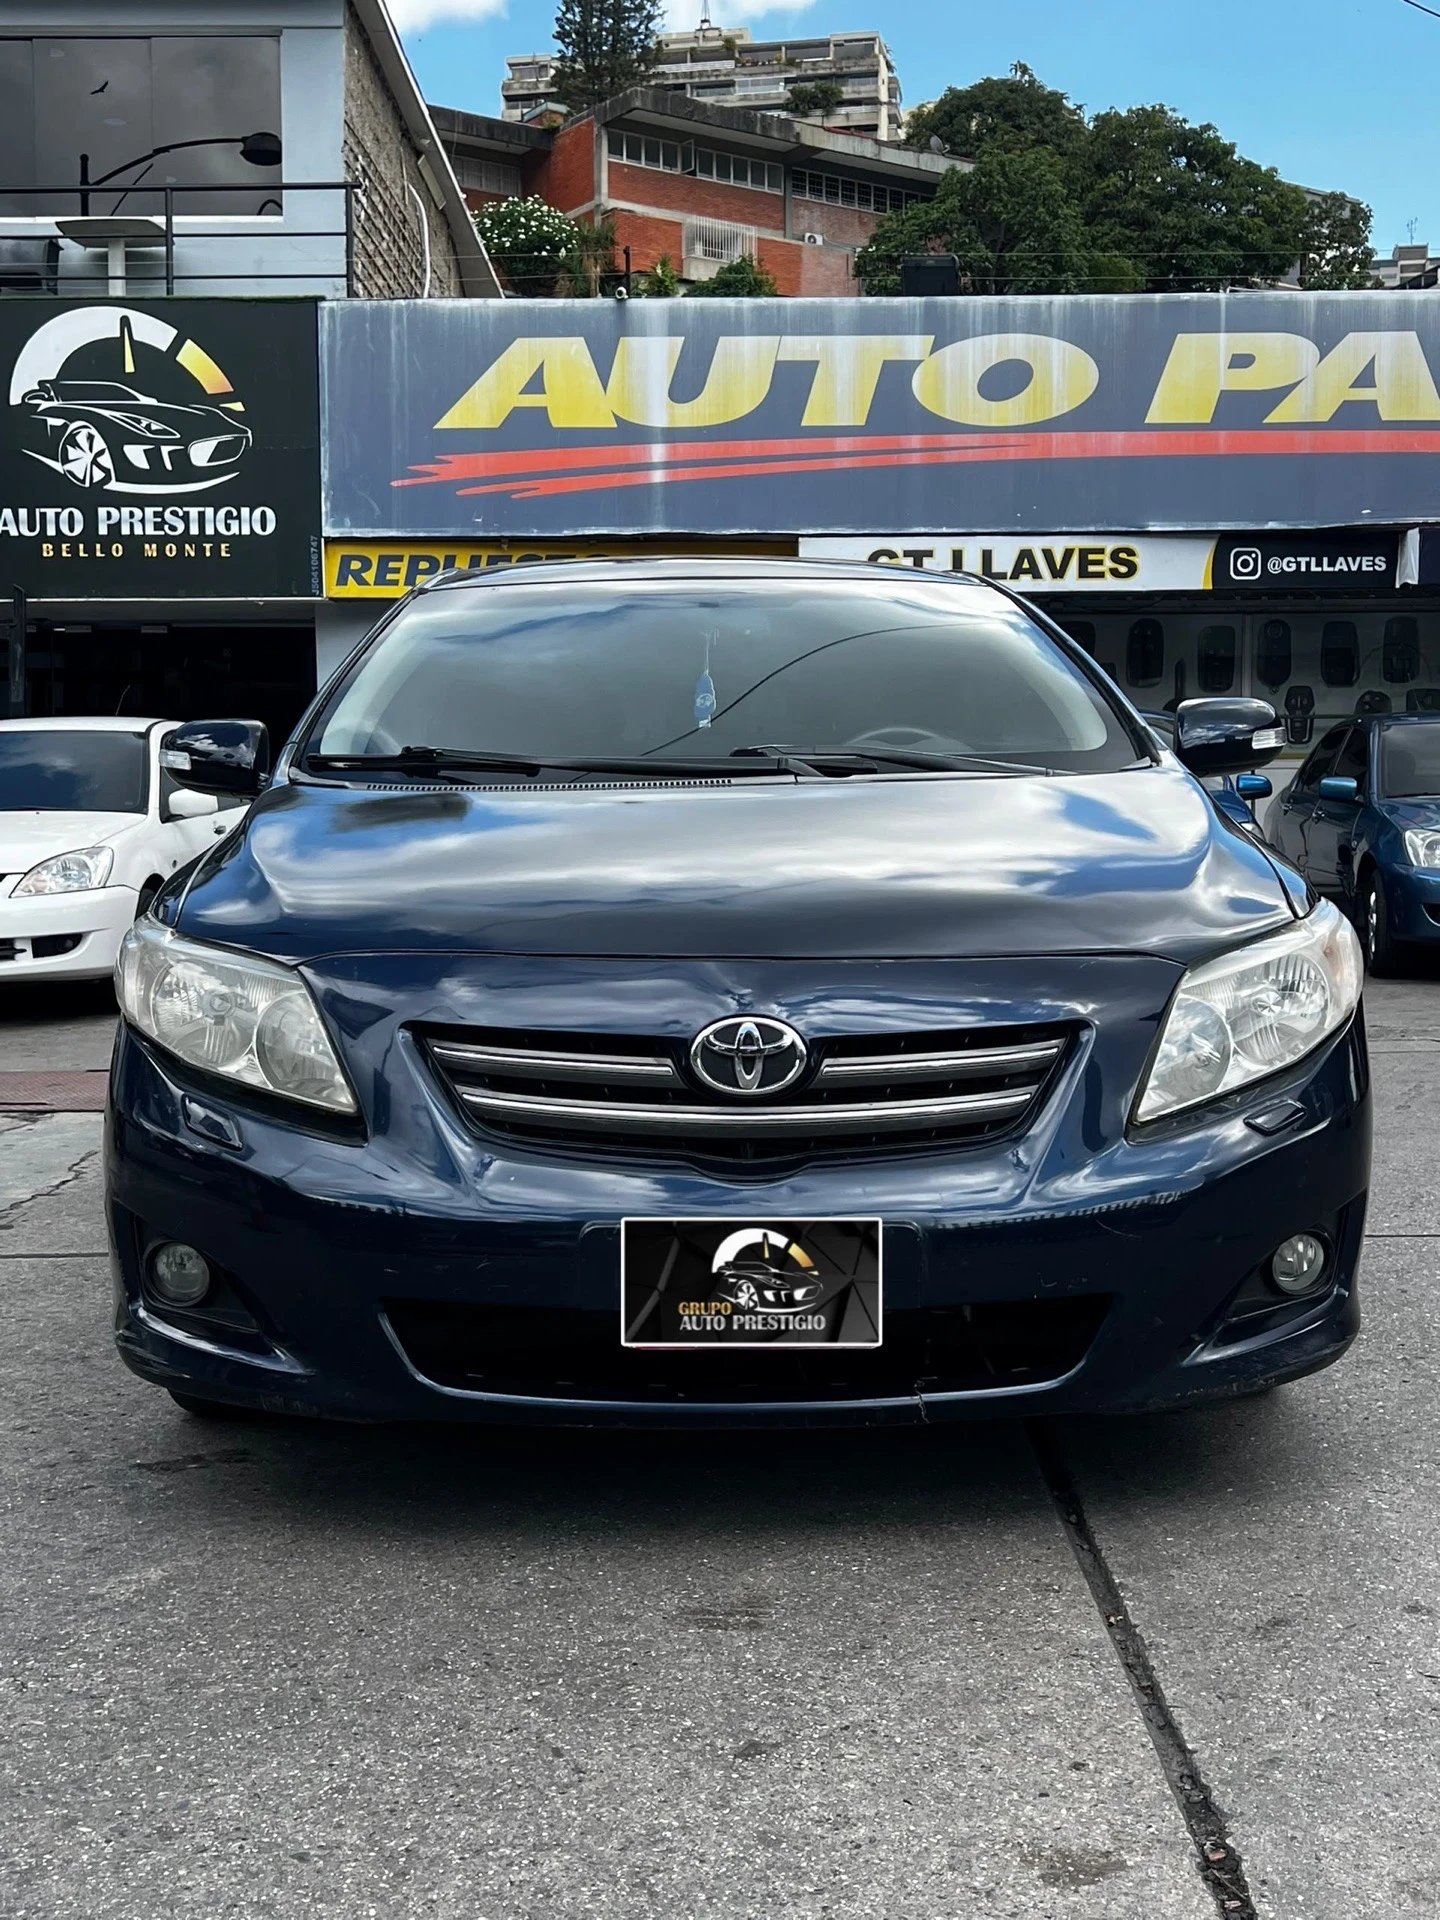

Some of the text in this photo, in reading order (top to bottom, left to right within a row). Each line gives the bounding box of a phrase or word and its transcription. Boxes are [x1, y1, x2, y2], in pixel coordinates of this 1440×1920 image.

[433, 333, 1099, 428] AUTO
[0, 506, 277, 537] AUTO PRESTIGIO
[42, 543, 231, 557] BELLO MONTE
[1267, 556, 1387, 575] @GTLLAVES
